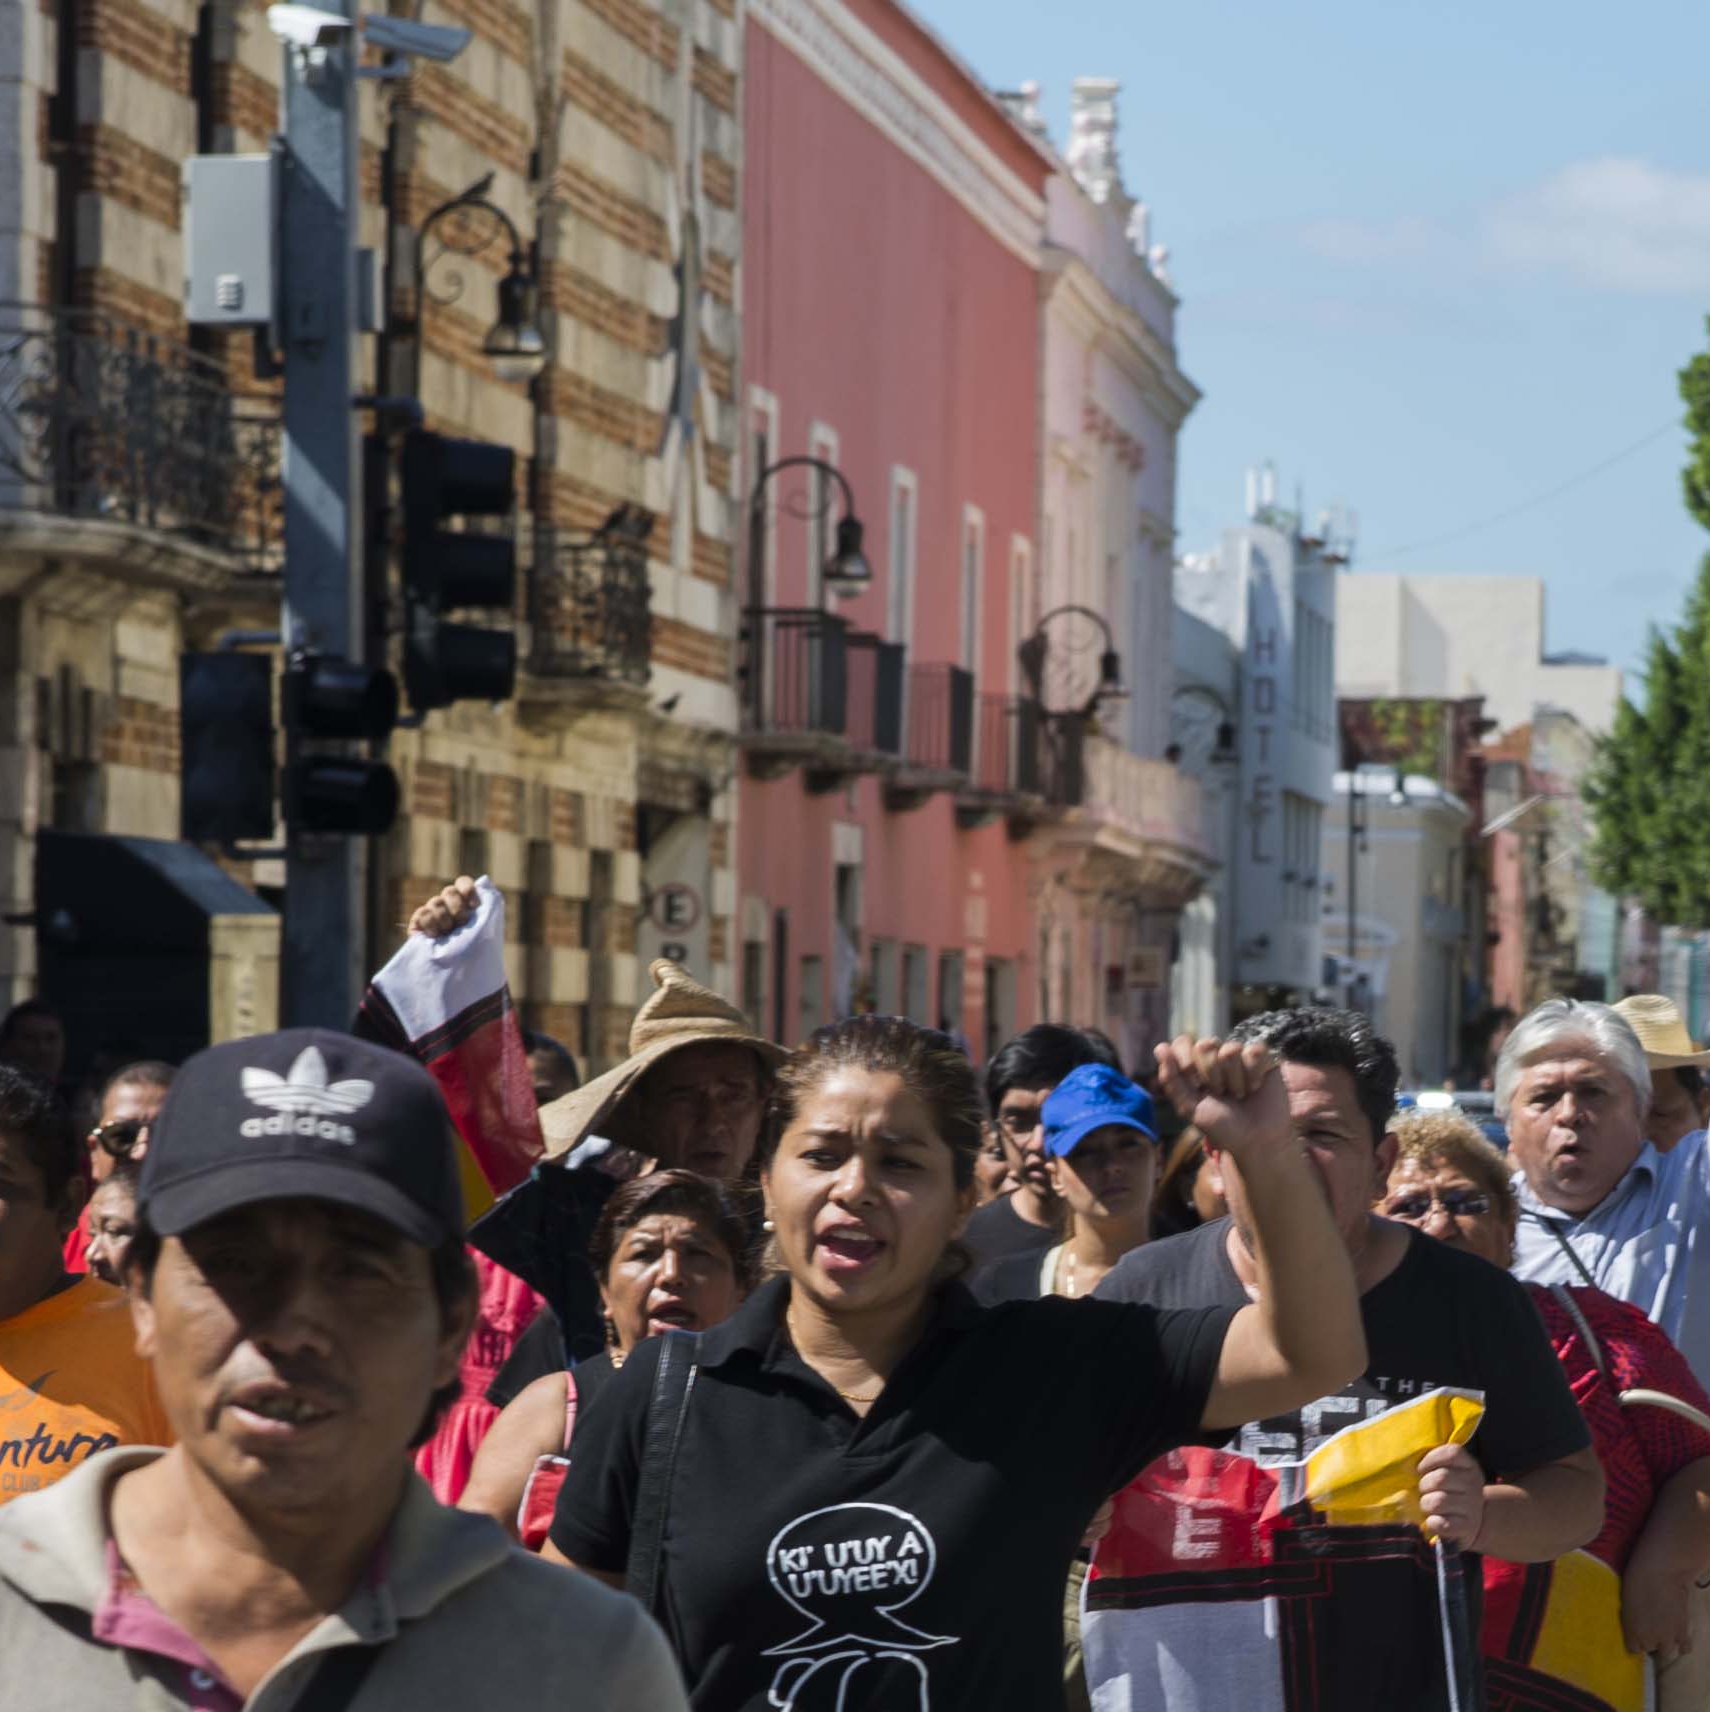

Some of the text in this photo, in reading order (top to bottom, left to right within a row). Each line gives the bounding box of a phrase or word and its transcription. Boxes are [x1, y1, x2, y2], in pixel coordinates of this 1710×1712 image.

[1253, 627, 1278, 865] HOTEL
[240, 1112, 355, 1146] adidas
[778, 1530, 924, 1573] KI' U'UY A
